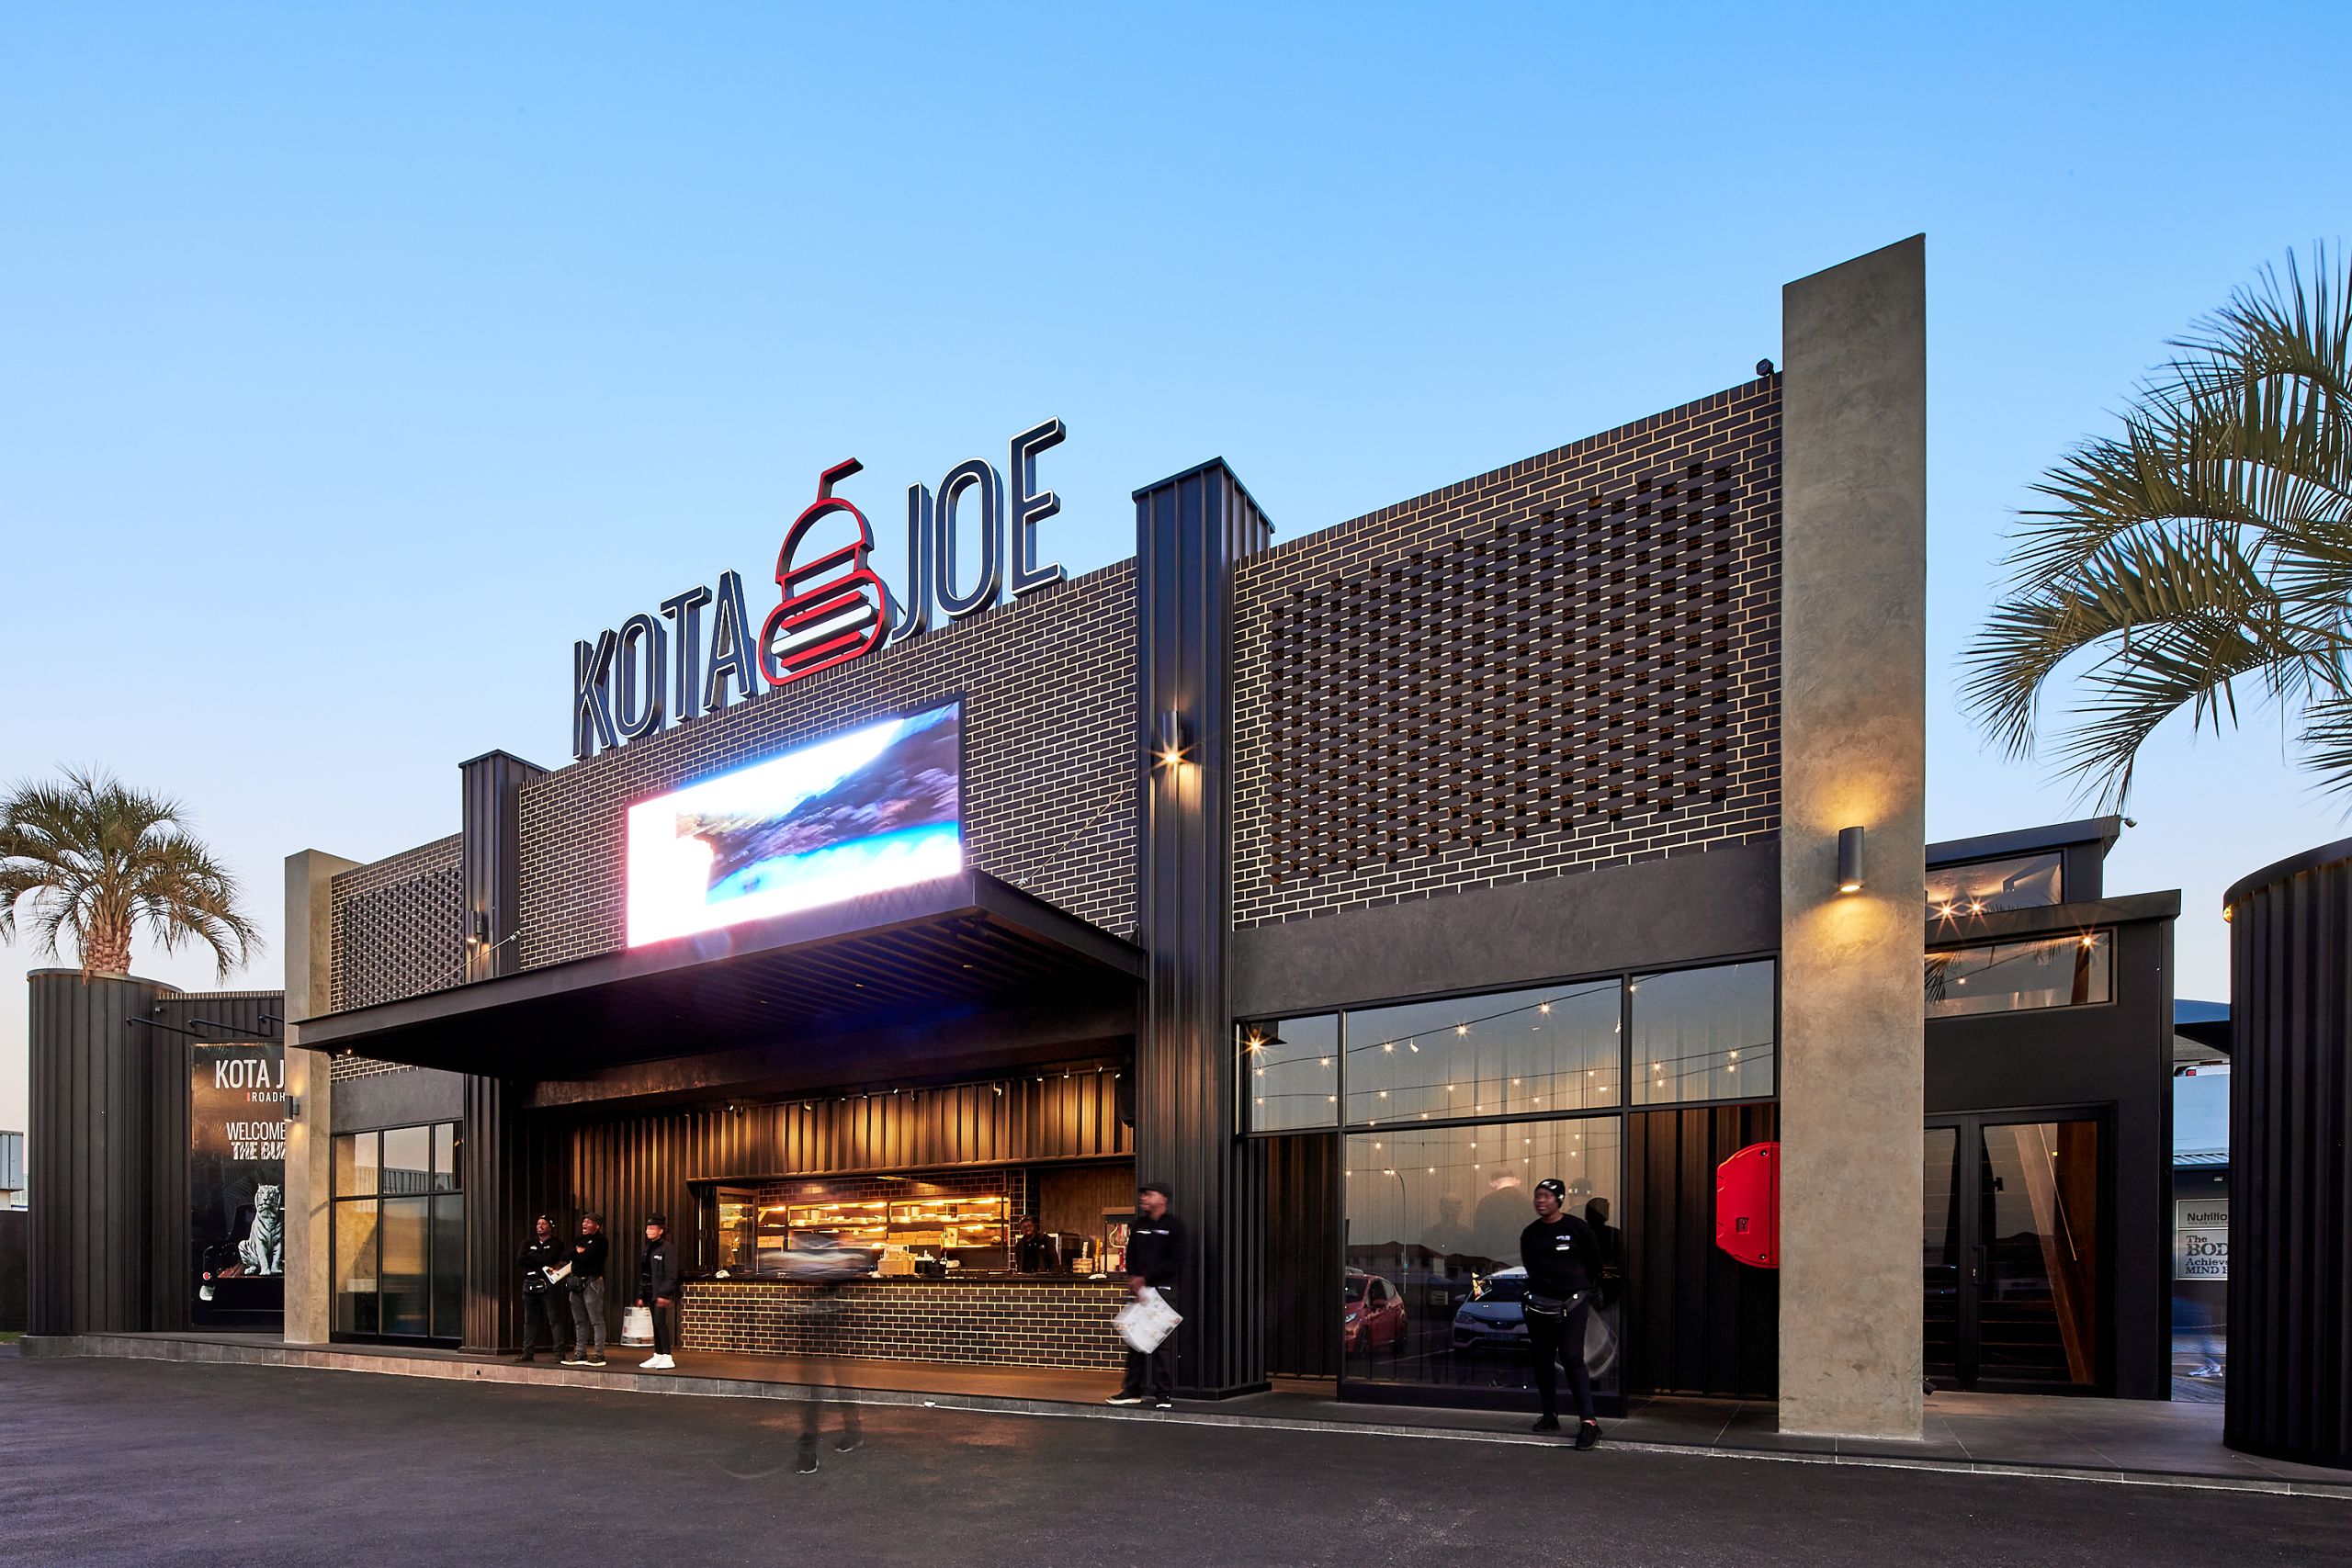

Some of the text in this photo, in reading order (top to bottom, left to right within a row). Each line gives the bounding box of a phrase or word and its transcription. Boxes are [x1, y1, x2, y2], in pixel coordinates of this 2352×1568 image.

[572, 415, 1067, 761] KOTA JOE
[215, 1059, 271, 1089] KOTA
[251, 1091, 286, 1102] ROADH
[226, 1122, 287, 1141] WELCOME
[231, 1142, 258, 1160] THE
[2186, 1235, 2208, 1244] The
[2186, 1243, 2228, 1257] BOD
[2186, 1267, 2220, 1275] MIND
